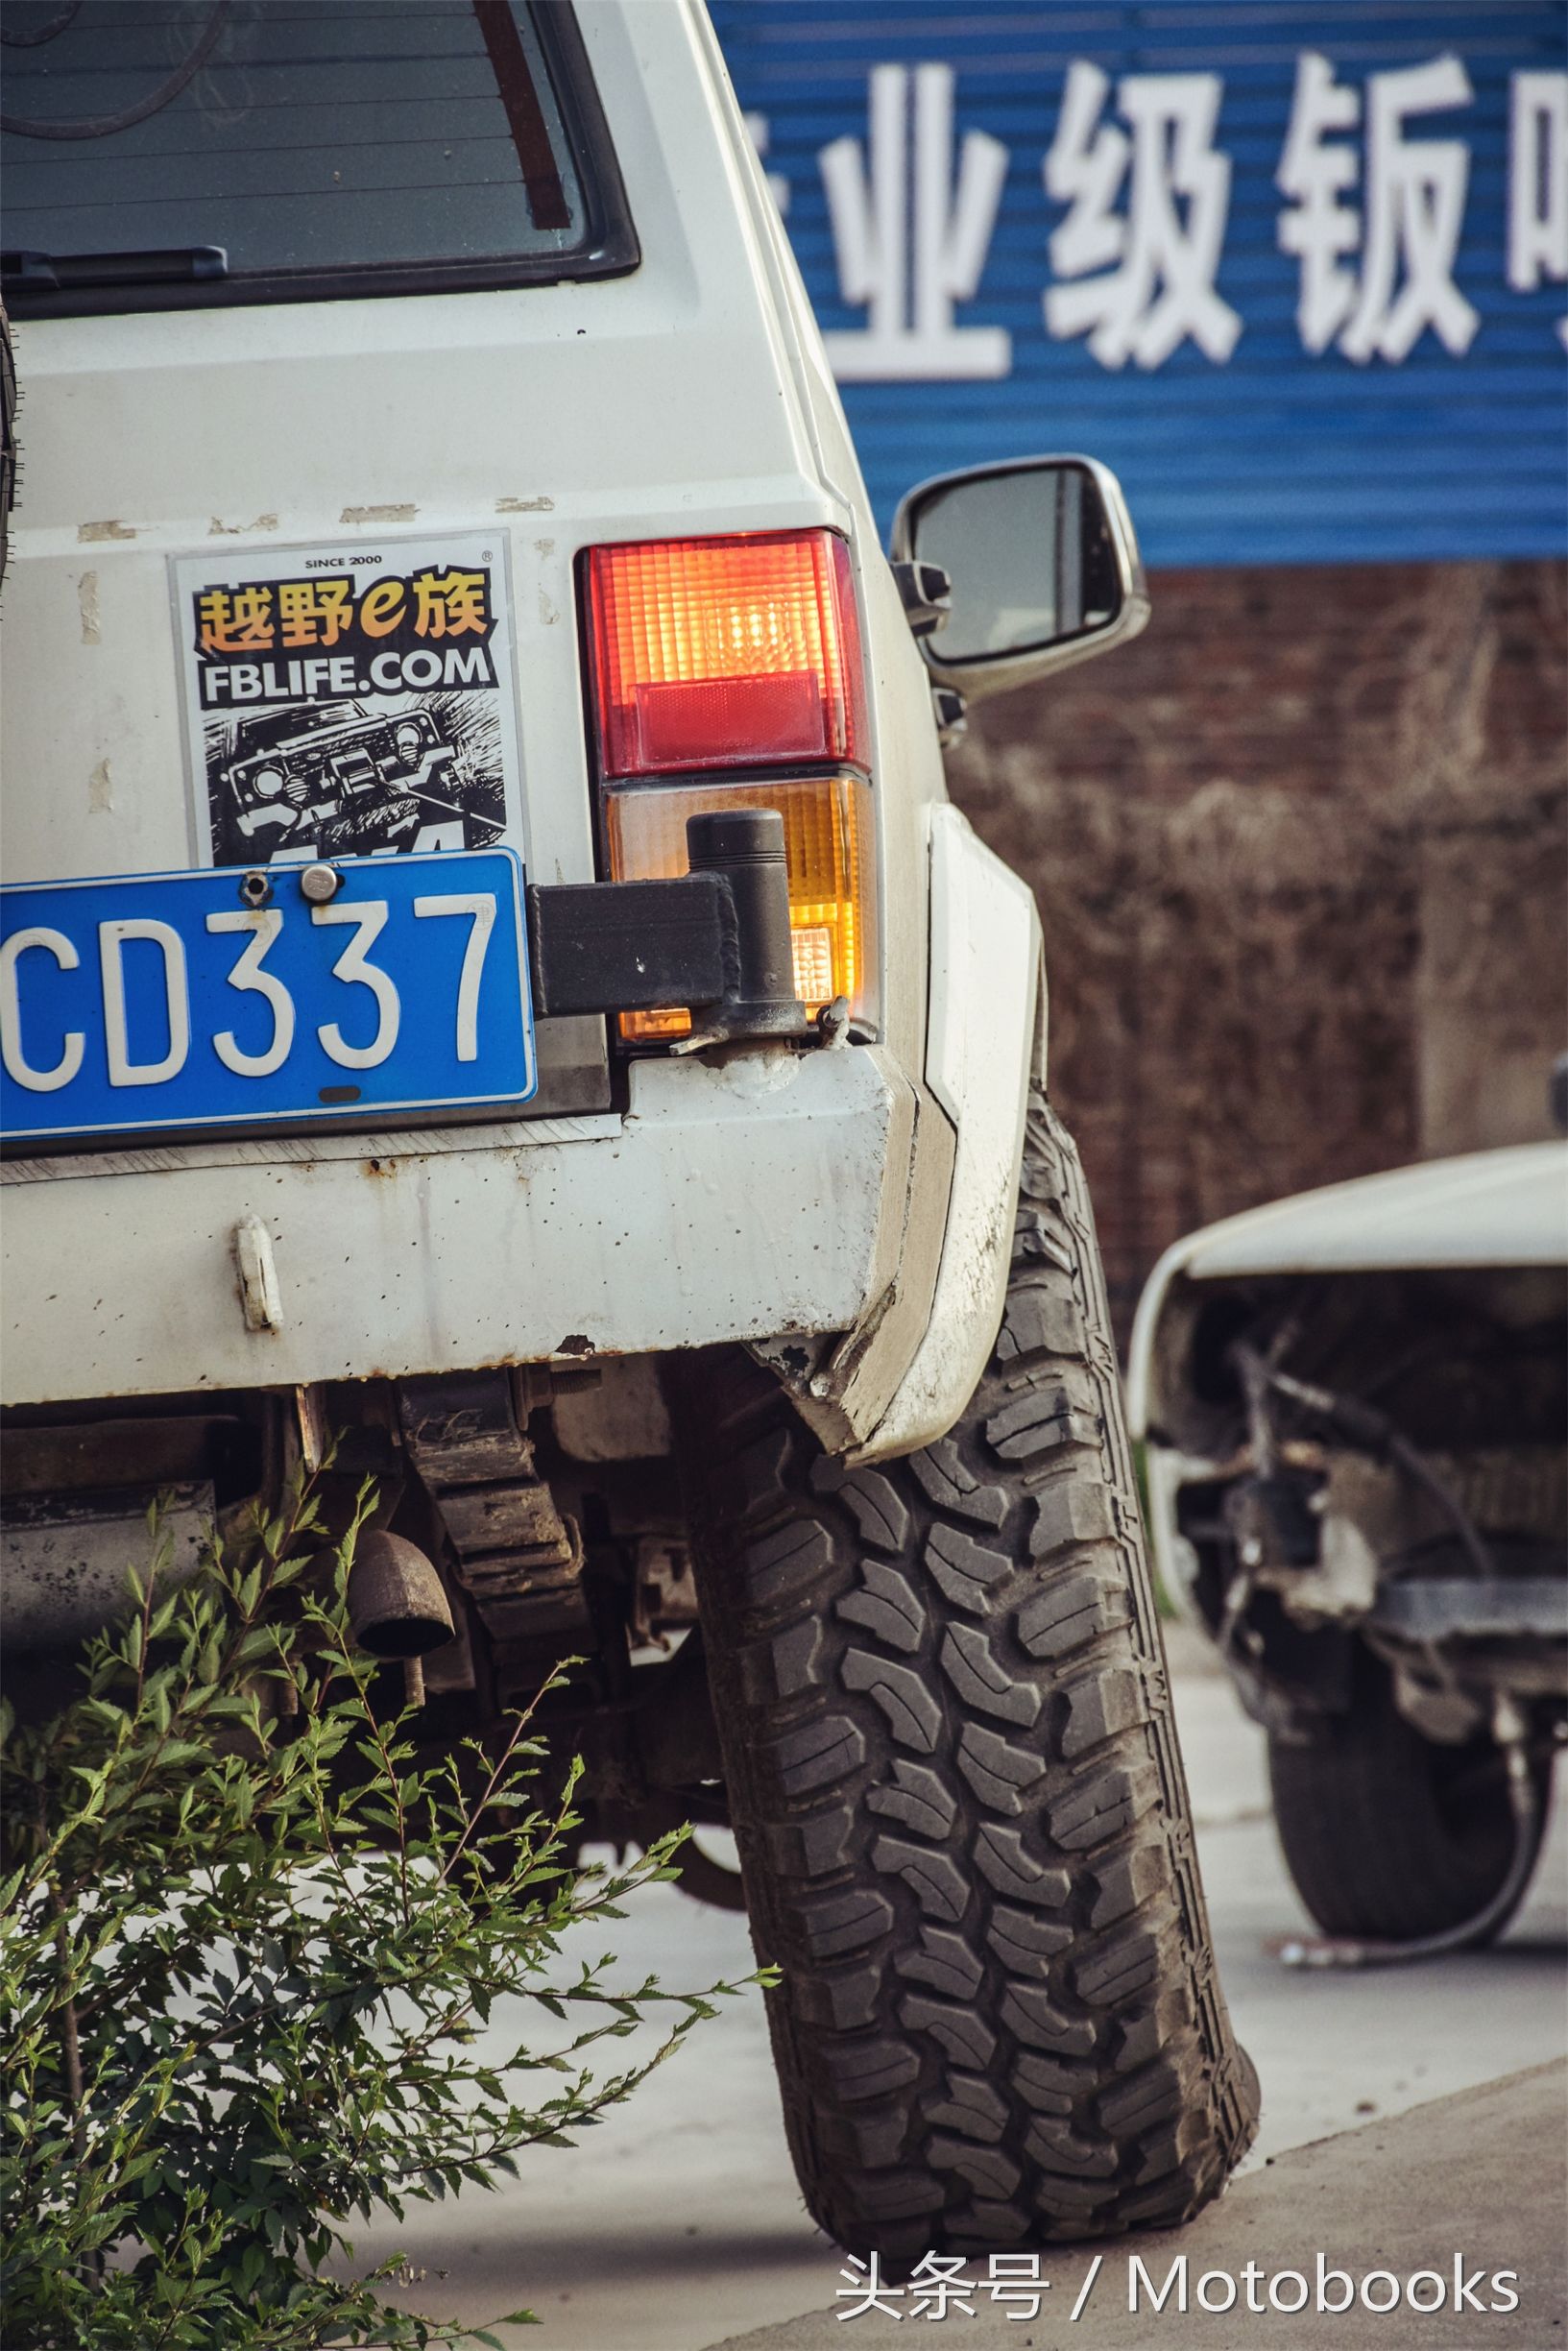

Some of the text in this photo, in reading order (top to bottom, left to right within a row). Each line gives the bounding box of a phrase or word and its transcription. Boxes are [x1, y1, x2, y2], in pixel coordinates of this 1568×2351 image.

[741, 50, 1568, 379] 业级钣
[304, 554, 383, 569] SINCE 2000
[198, 568, 489, 653] 越野e族
[205, 646, 492, 702] FBLIFE.COM
[0, 892, 498, 1093] CD337
